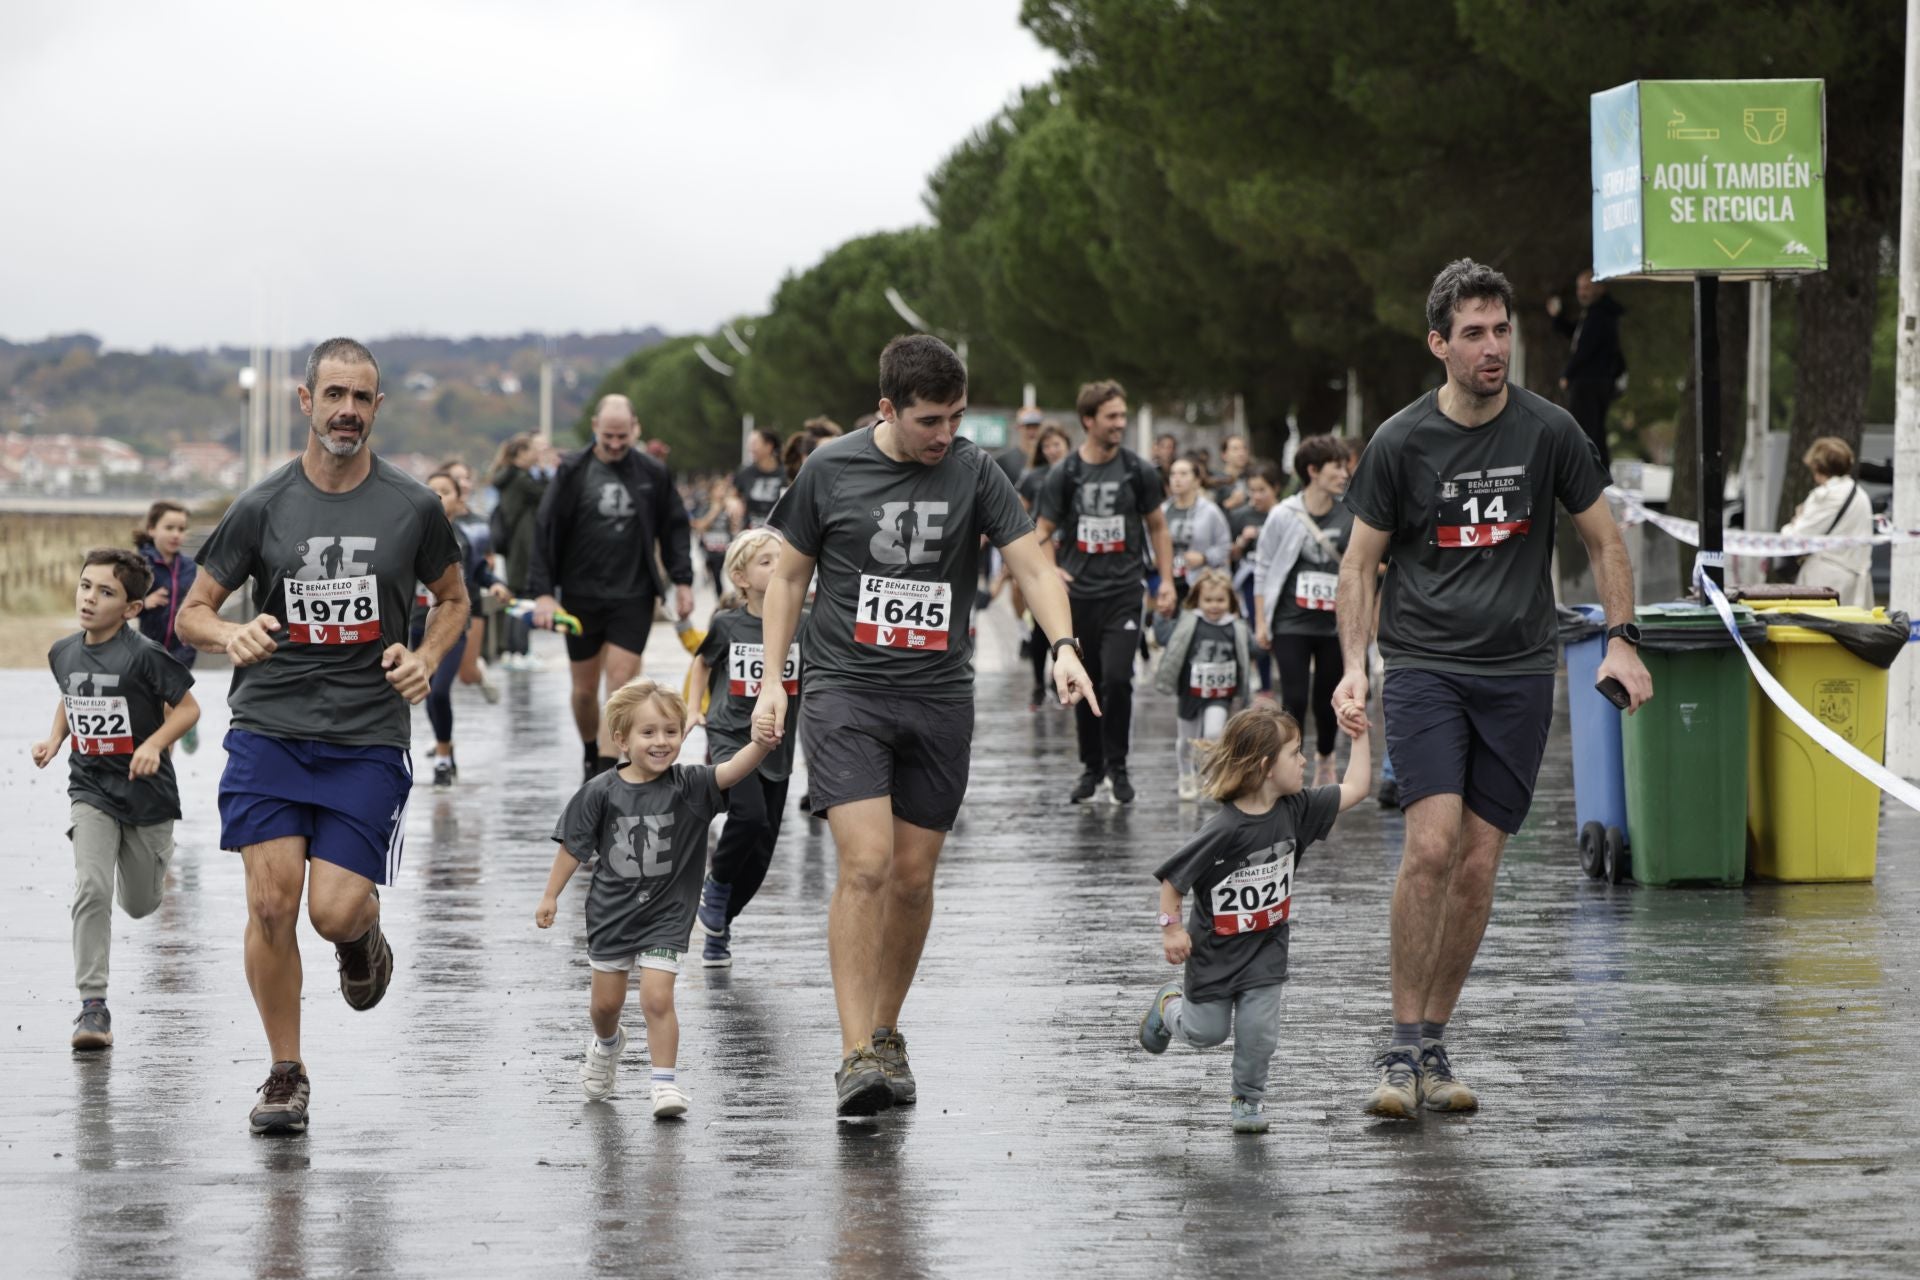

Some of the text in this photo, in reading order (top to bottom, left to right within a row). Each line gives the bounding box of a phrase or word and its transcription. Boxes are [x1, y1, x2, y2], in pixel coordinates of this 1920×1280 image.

[1653, 155, 1708, 193] AQUÍ
[1713, 154, 1810, 189] TAMBIÉN
[1670, 196, 1696, 223] SE
[1703, 195, 1795, 223] RECICLA
[1467, 478, 1515, 489] BEÑAT ELZO
[1462, 495, 1508, 524] 14
[1082, 527, 1121, 541] 1636
[305, 581, 352, 591] BEÑAT ELZO
[885, 581, 930, 592] BEÑAT ELZO
[1303, 583, 1338, 598] 163
[292, 596, 373, 623] 1978
[864, 597, 944, 628] 1645
[735, 660, 795, 679] 169
[68, 712, 127, 736] 1522
[1234, 868, 1260, 878] BEÑAT
[1218, 872, 1289, 912] 2021
